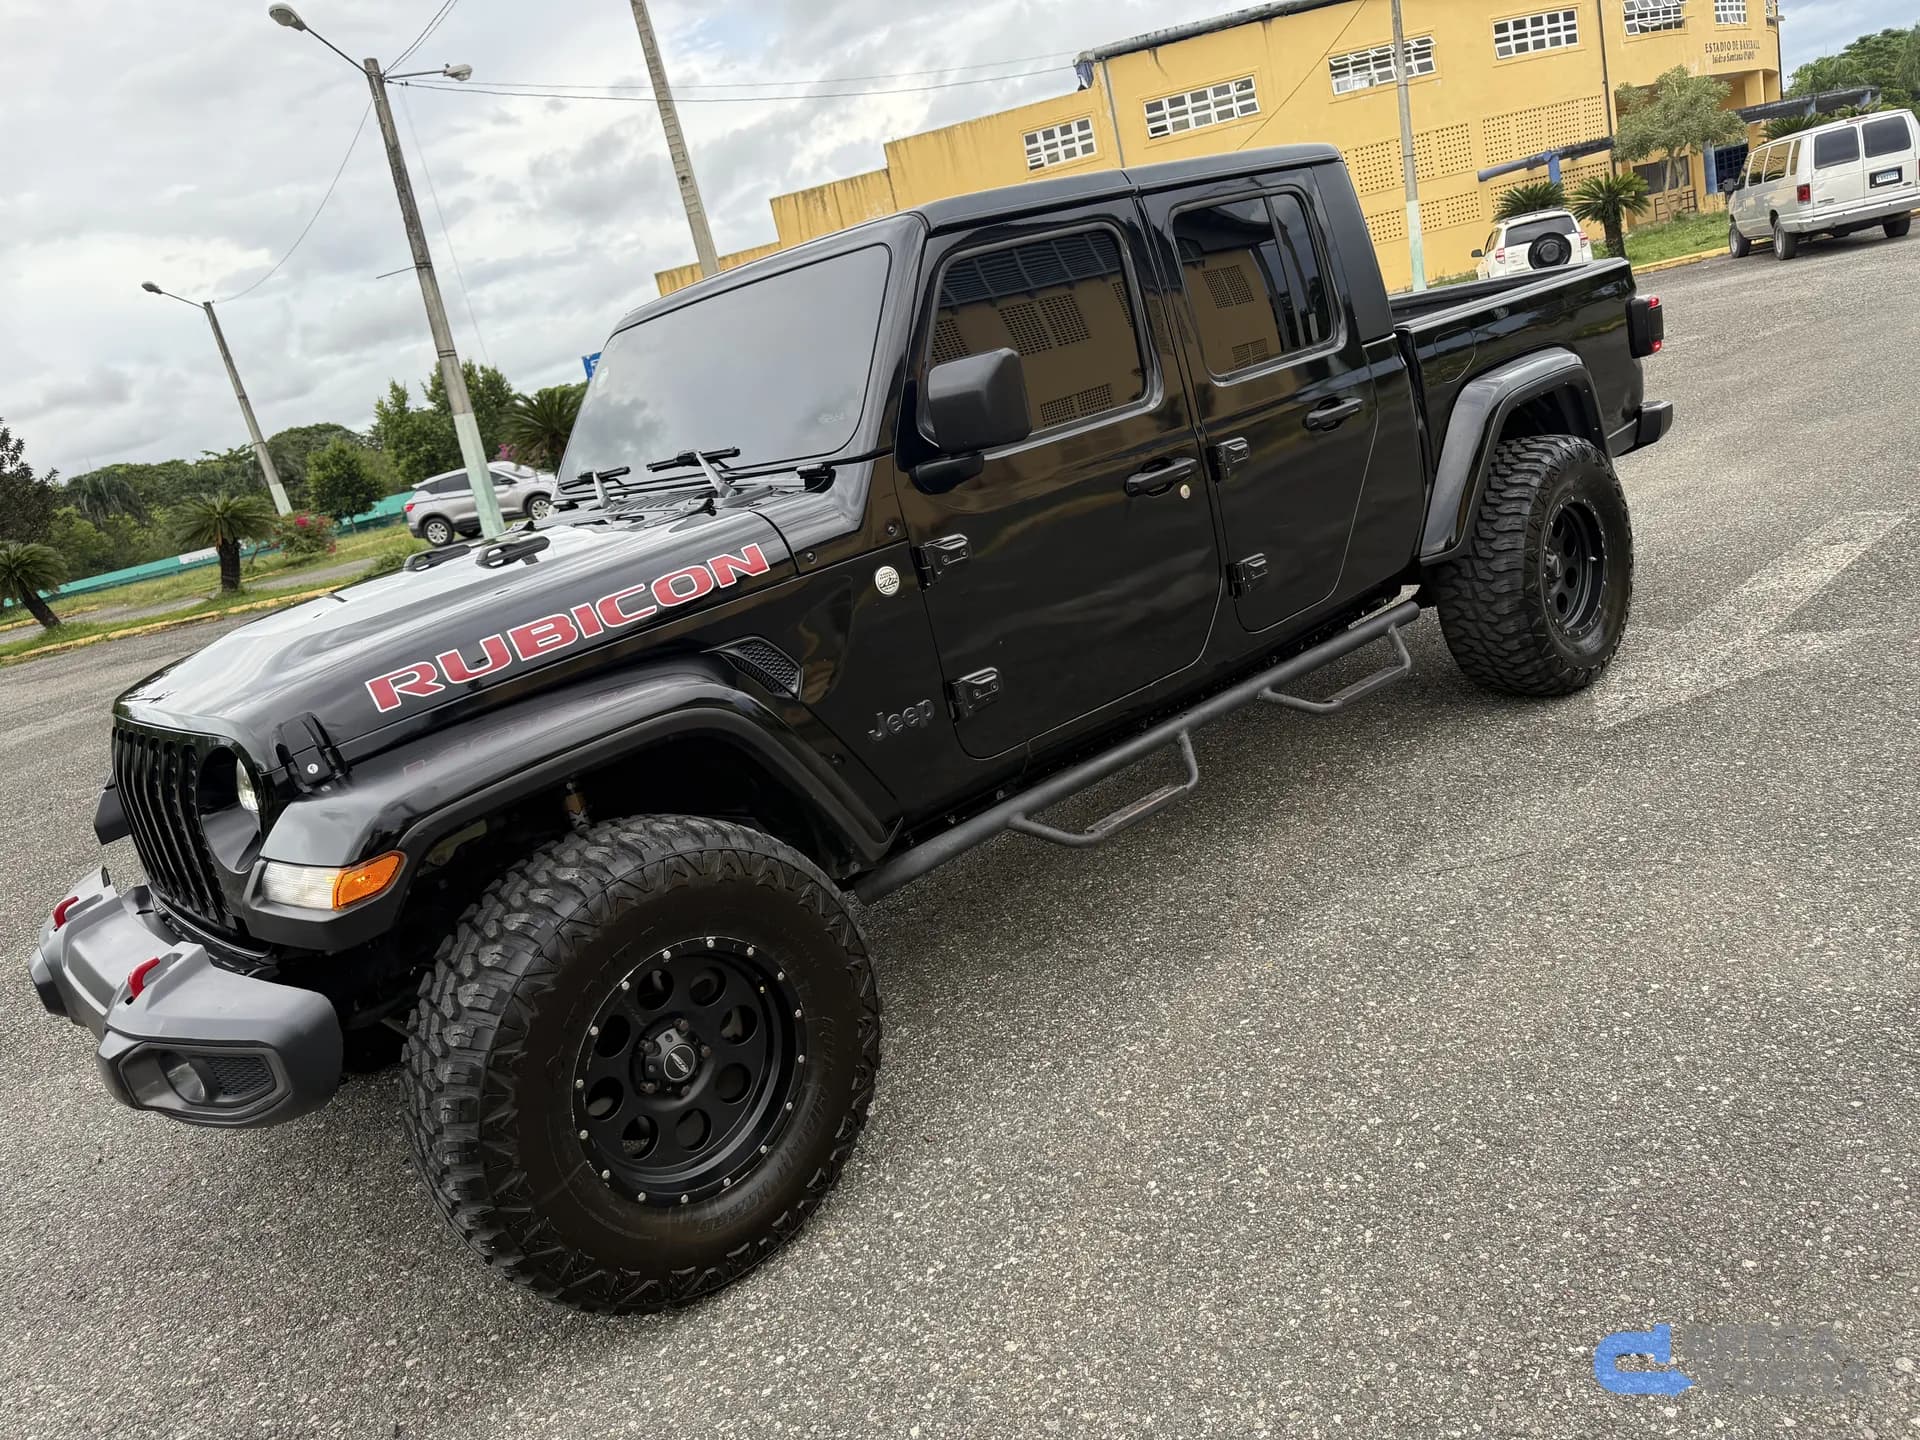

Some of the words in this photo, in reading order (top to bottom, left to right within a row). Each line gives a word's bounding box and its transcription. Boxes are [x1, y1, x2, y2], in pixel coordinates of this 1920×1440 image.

[1705, 42, 1732, 53] ESTADIO
[1732, 40, 1739, 51] DE
[365, 543, 770, 713] RUBICON
[867, 699, 935, 741] Jeep
